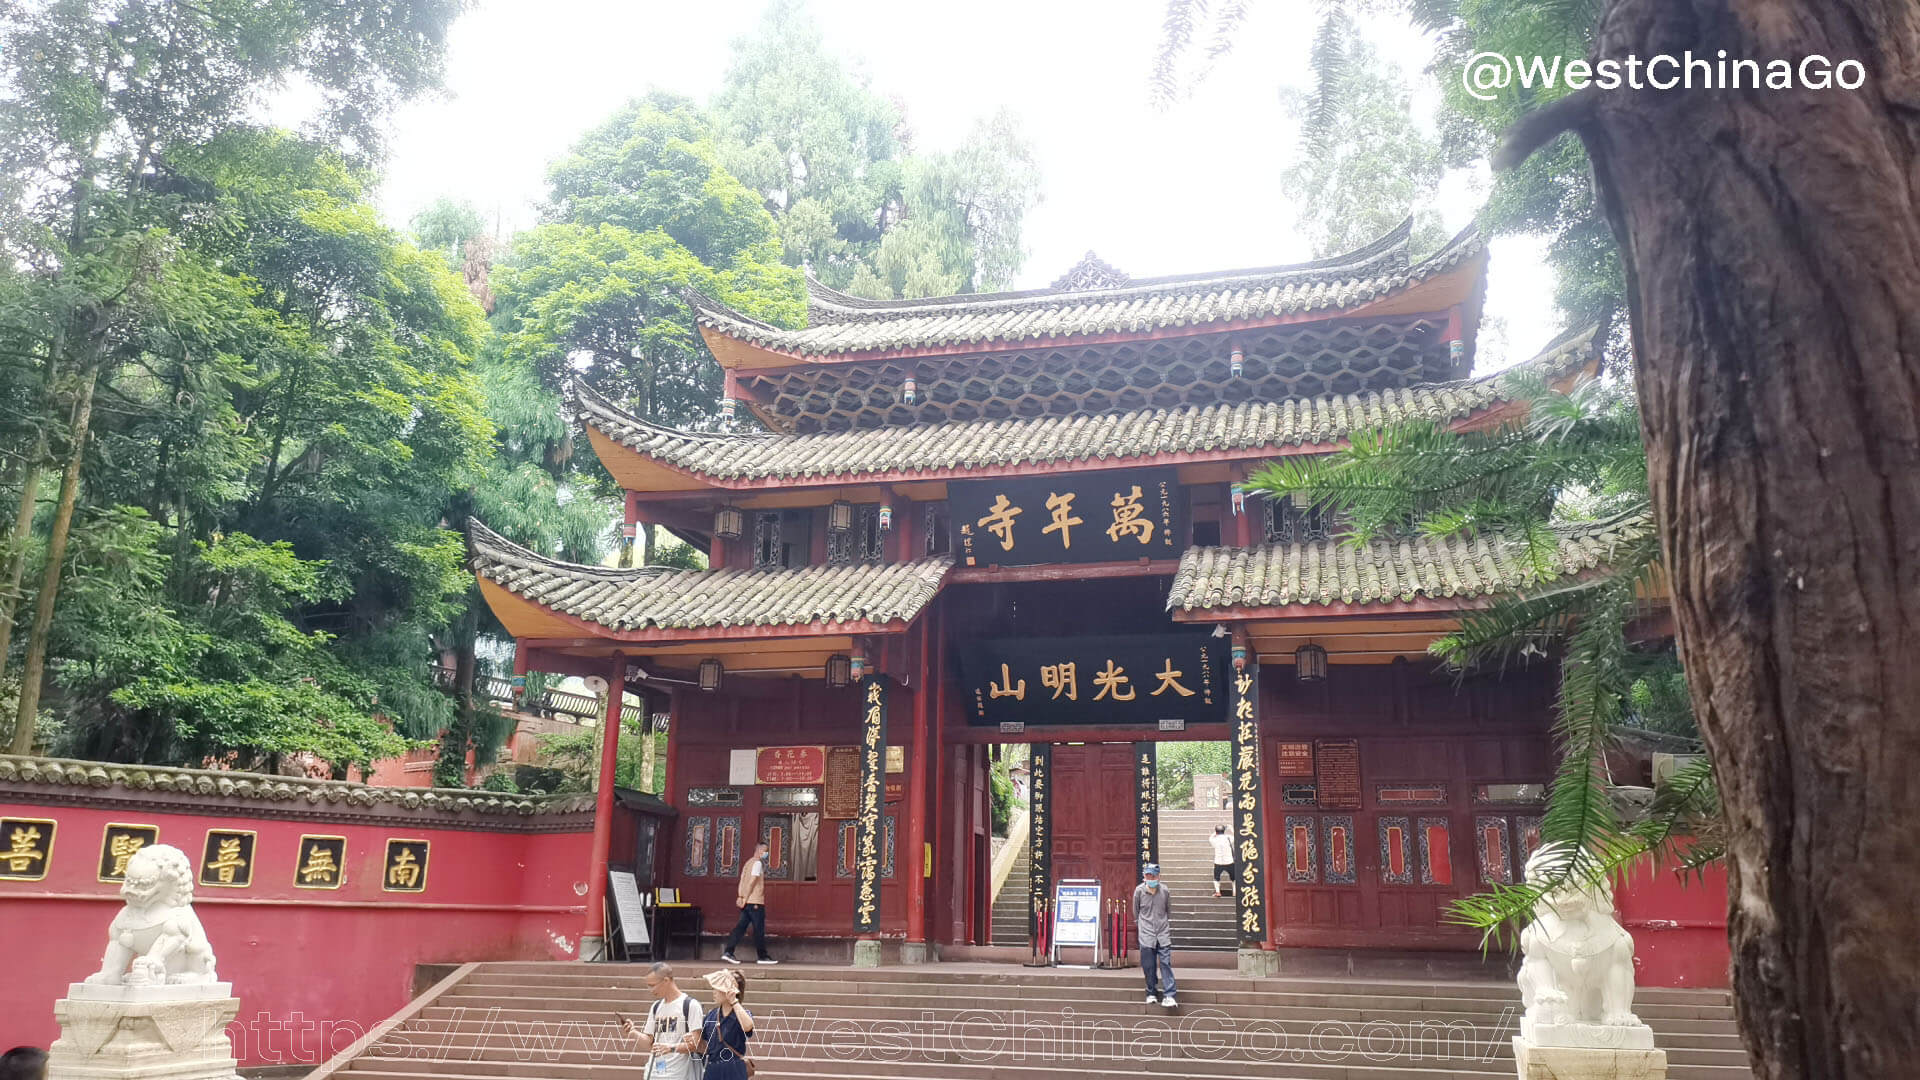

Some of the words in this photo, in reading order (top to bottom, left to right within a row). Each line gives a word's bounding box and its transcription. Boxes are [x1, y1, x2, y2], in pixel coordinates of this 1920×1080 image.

[977, 485, 1155, 551] 萬年寺
[989, 657, 1197, 701] 大光明山
